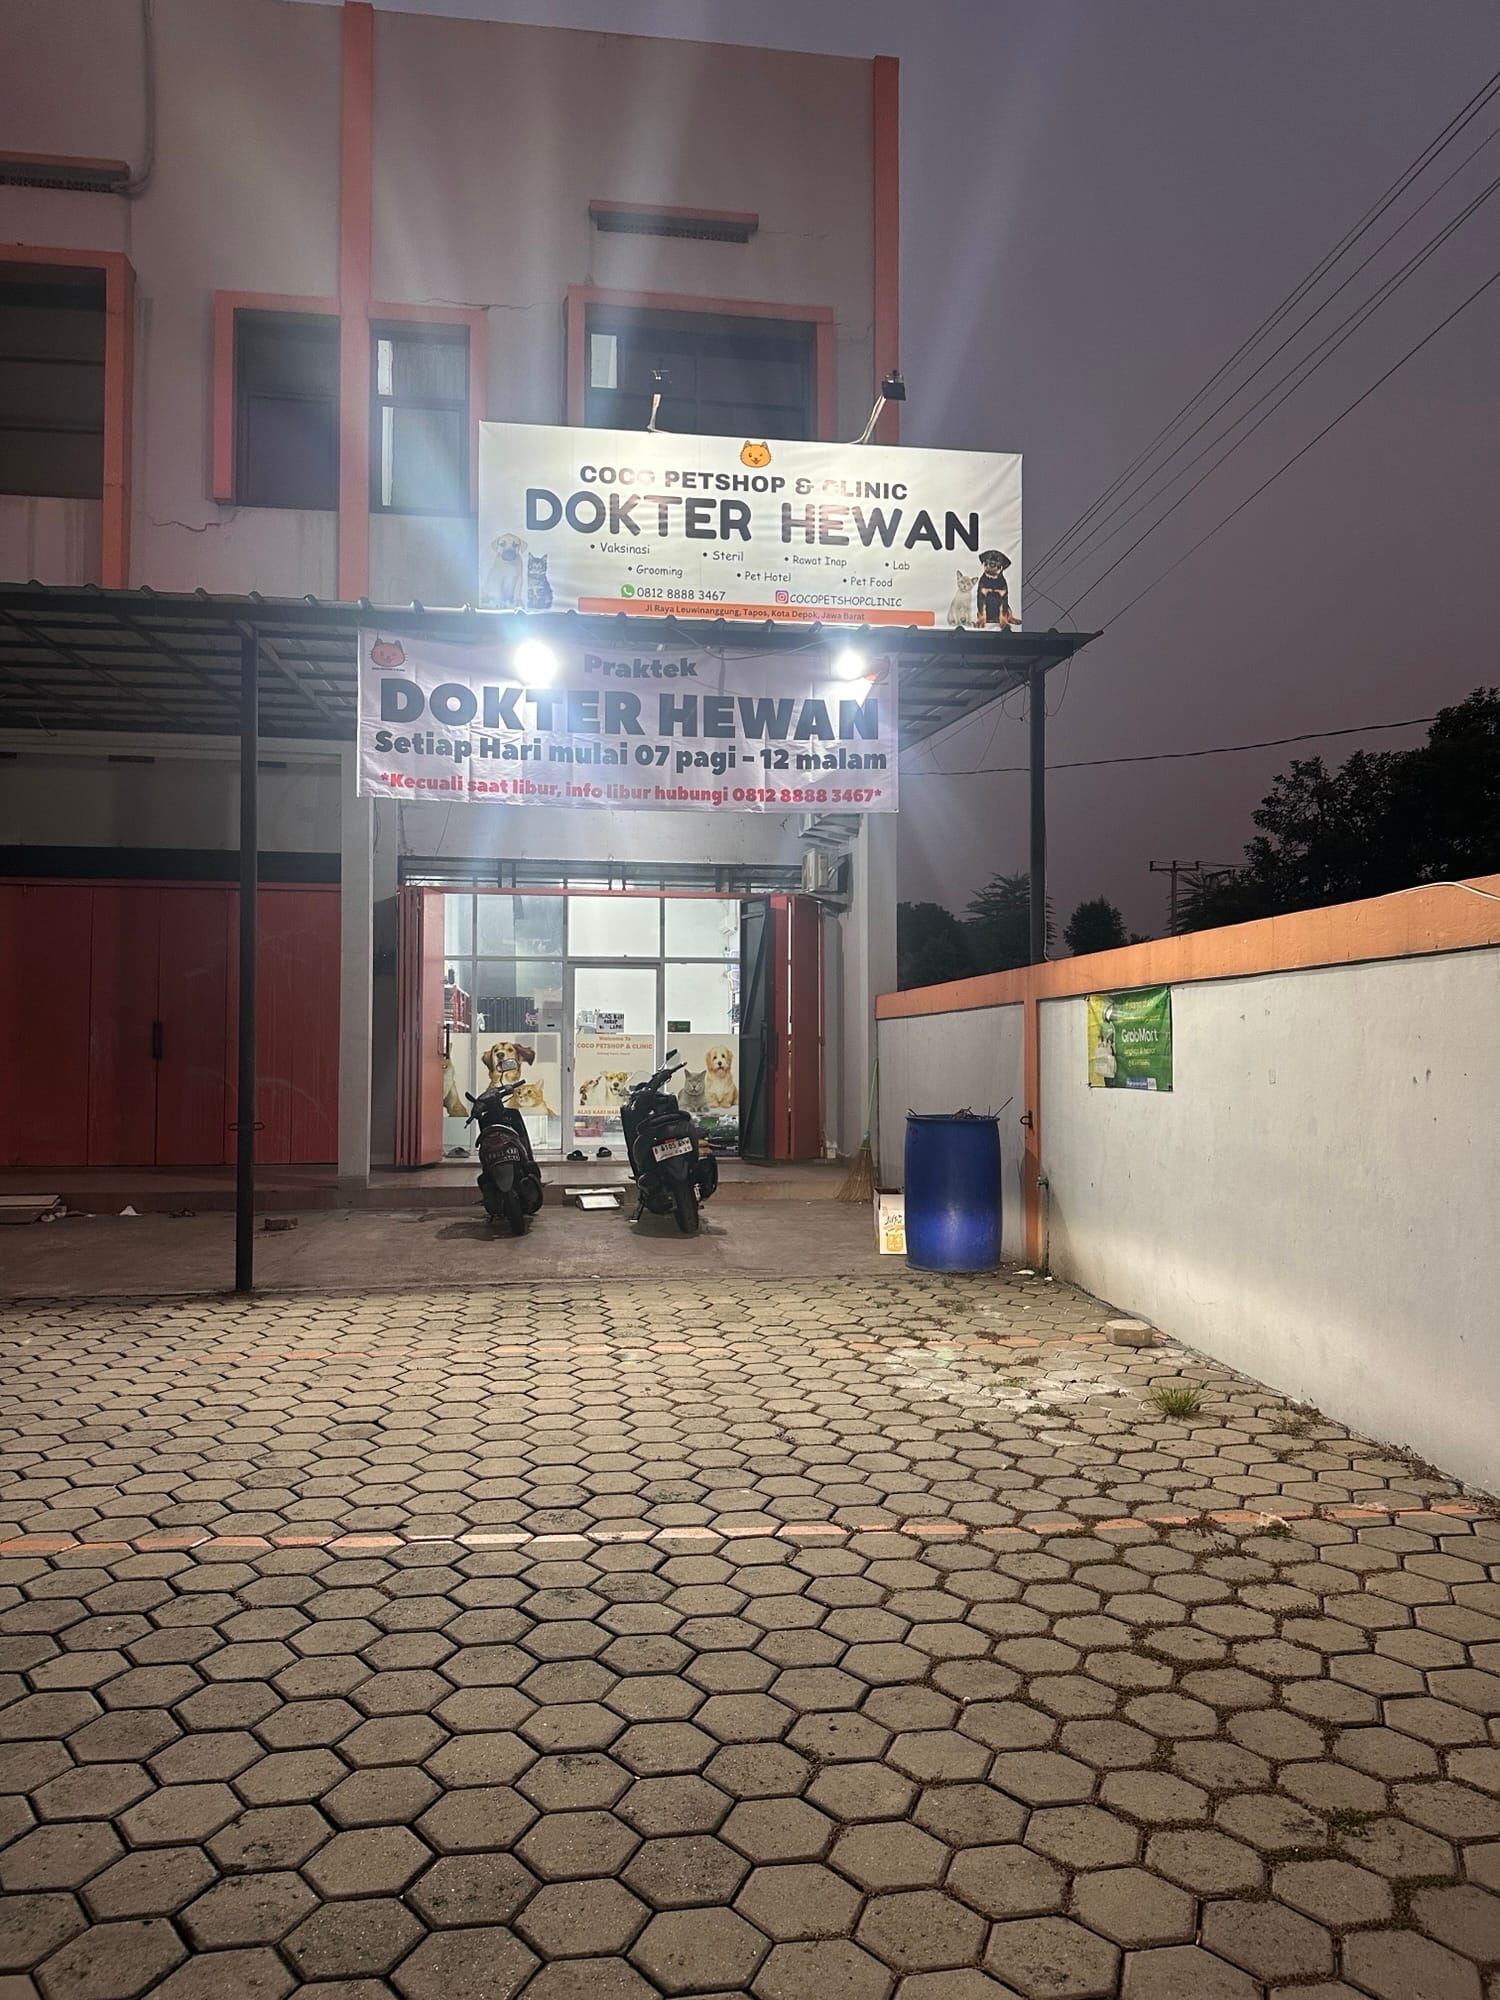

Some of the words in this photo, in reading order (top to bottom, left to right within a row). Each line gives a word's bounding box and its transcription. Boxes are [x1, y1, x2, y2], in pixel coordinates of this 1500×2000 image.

[580, 465, 655, 486] COCO
[664, 470, 785, 493] PETSHOP
[795, 478, 814, 495] &
[822, 480, 908, 500] CLINIC
[526, 488, 752, 542] DOKTER
[782, 502, 979, 551] HEWAN
[600, 543, 650, 555] Vaksinasi
[713, 551, 744, 562] Steril
[793, 555, 821, 566] Rawat
[825, 556, 847, 568] Inap
[636, 565, 683, 578] Grooming
[893, 560, 910, 570] Lab
[745, 571, 761, 581] Pet
[765, 572, 791, 582] Hotel
[851, 577, 866, 587] Pet
[870, 578, 893, 588] Food
[637, 587, 663, 598] 0812
[667, 588, 695, 599] 8888
[699, 590, 726, 601] 3467
[790, 594, 902, 608] COCOPETSHOPCLINIC
[655, 605, 675, 614] Raya
[677, 606, 741, 617] Leuwinanggung,
[743, 609, 769, 618] Tapos,
[771, 609, 790, 618] Kota
[792, 610, 820, 620] Depok,
[821, 612, 841, 620] Jawa
[843, 612, 865, 621] Barat
[584, 654, 698, 679] Praktek
[380, 678, 645, 735] DOKTER
[659, 693, 879, 740] HEWAN
[375, 731, 472, 763] Setiap
[479, 737, 541, 761] Hari
[549, 742, 627, 765] mulai
[634, 745, 670, 766] 07
[676, 746, 736, 775] pagi
[759, 749, 789, 770] 12
[796, 749, 887, 770] malam
[467, 779, 508, 793] saat
[512, 779, 561, 798] libur,
[566, 781, 602, 798] info
[606, 784, 651, 800] libur
[654, 785, 728, 806] hubungi
[732, 788, 776, 803] 0812
[779, 788, 828, 803] 8888
[1121, 1028, 1159, 1043] GrabMart
